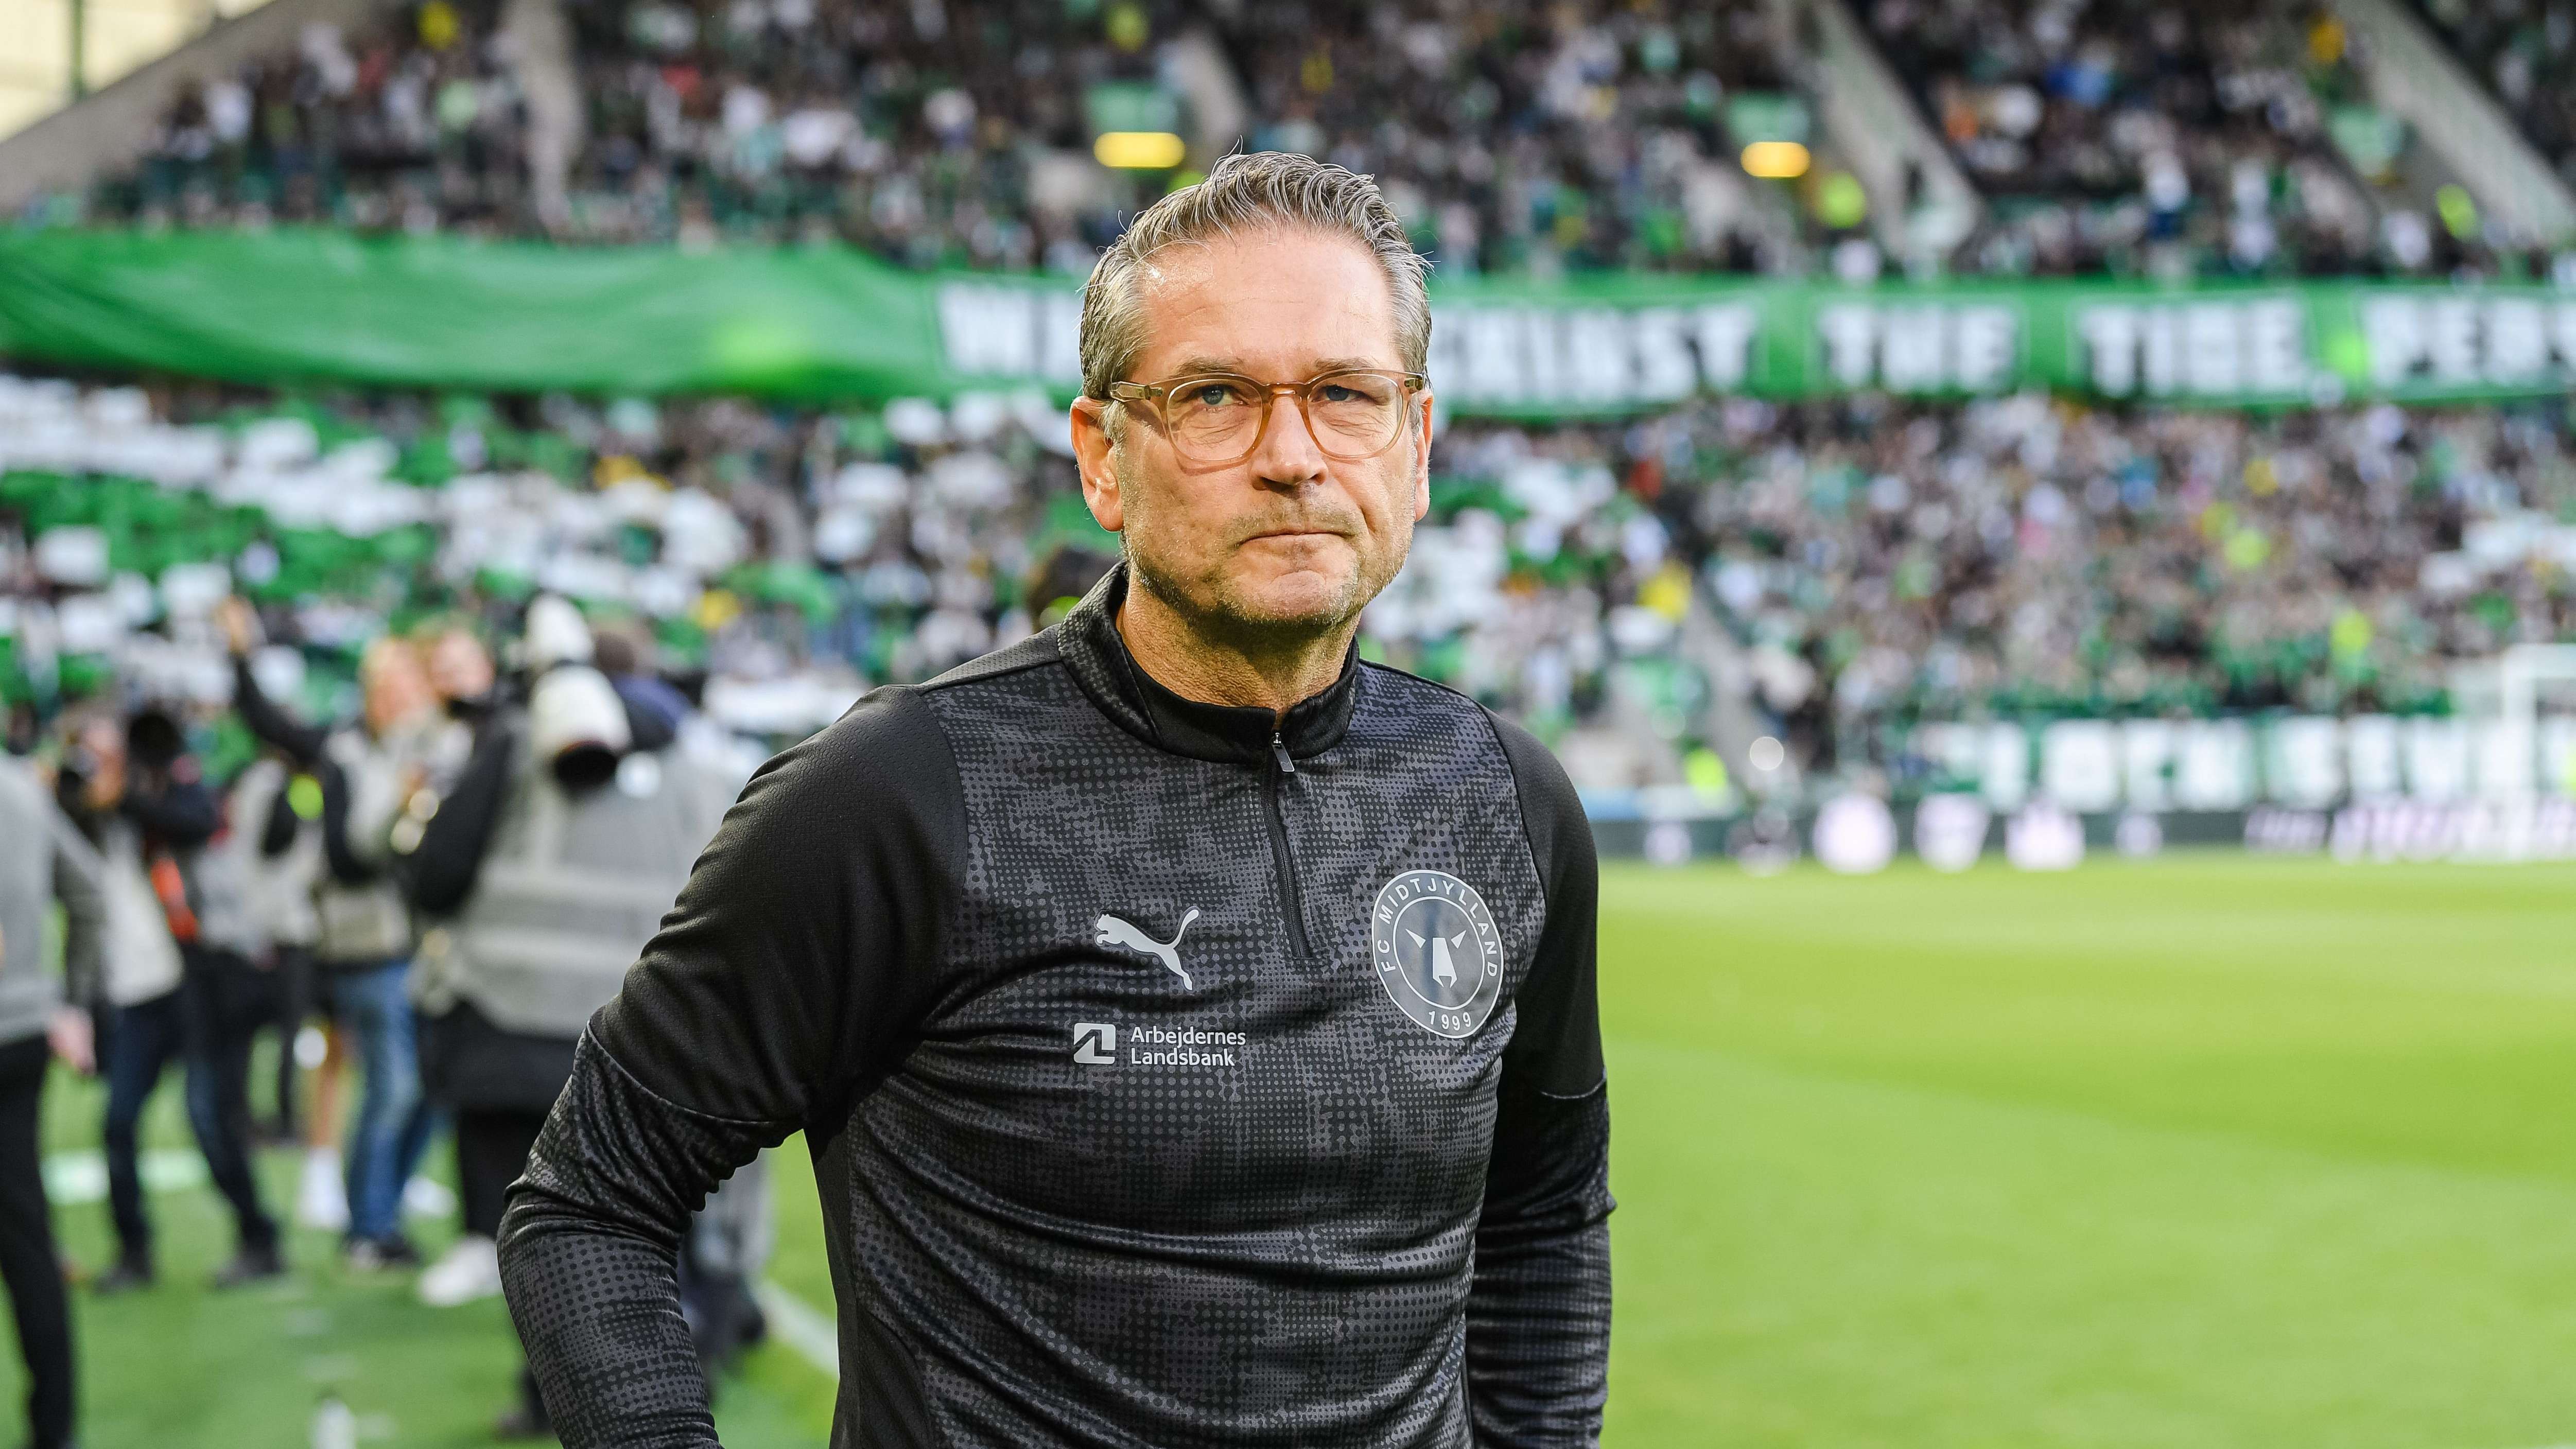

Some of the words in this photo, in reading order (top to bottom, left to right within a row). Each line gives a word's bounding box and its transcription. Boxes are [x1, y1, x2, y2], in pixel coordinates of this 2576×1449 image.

[1378, 877, 1498, 977] MIDTJYLLAND
[1377, 939, 1396, 972] FC
[1429, 1010, 1472, 1031] 1999
[1130, 1025, 1246, 1049] Arbejdernes
[1131, 1046, 1235, 1067] Landsbank
